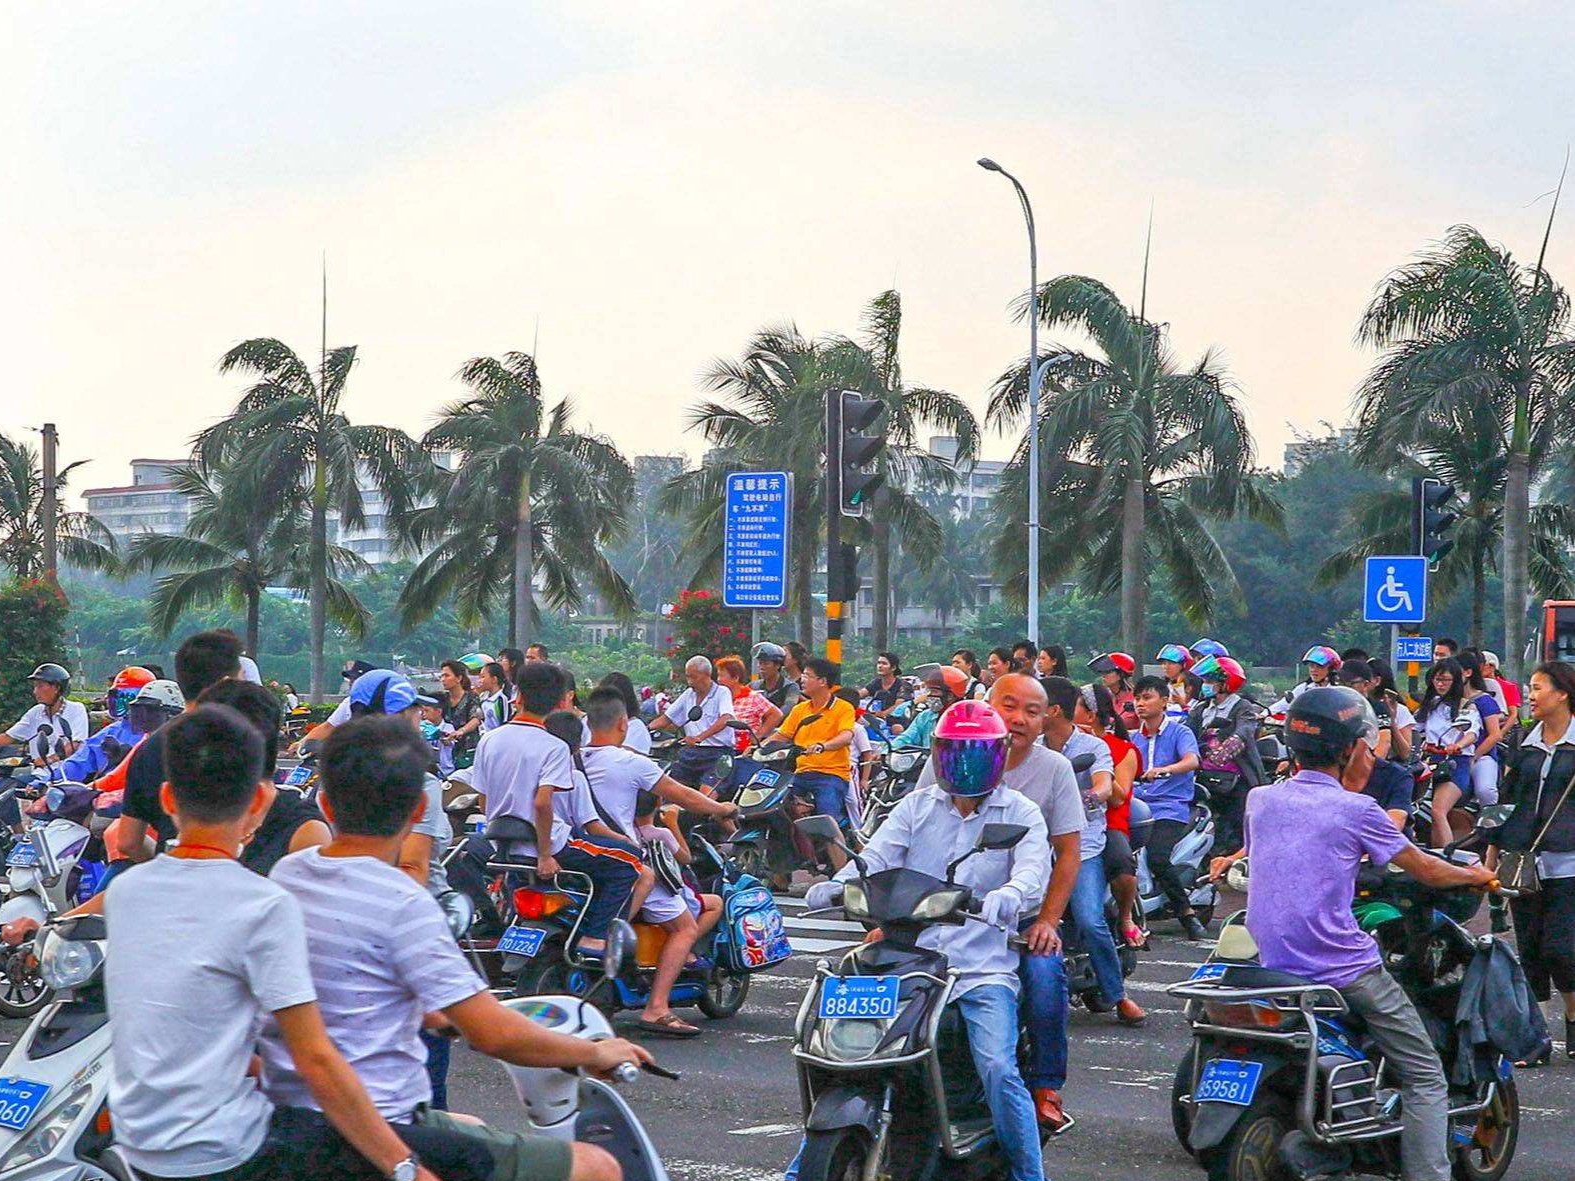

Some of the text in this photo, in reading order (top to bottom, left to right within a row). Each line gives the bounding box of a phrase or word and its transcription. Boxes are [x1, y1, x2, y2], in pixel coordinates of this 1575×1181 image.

[733, 478, 780, 491] 温馨提示
[499, 937, 536, 953] 701226
[826, 997, 892, 1015] 884350
